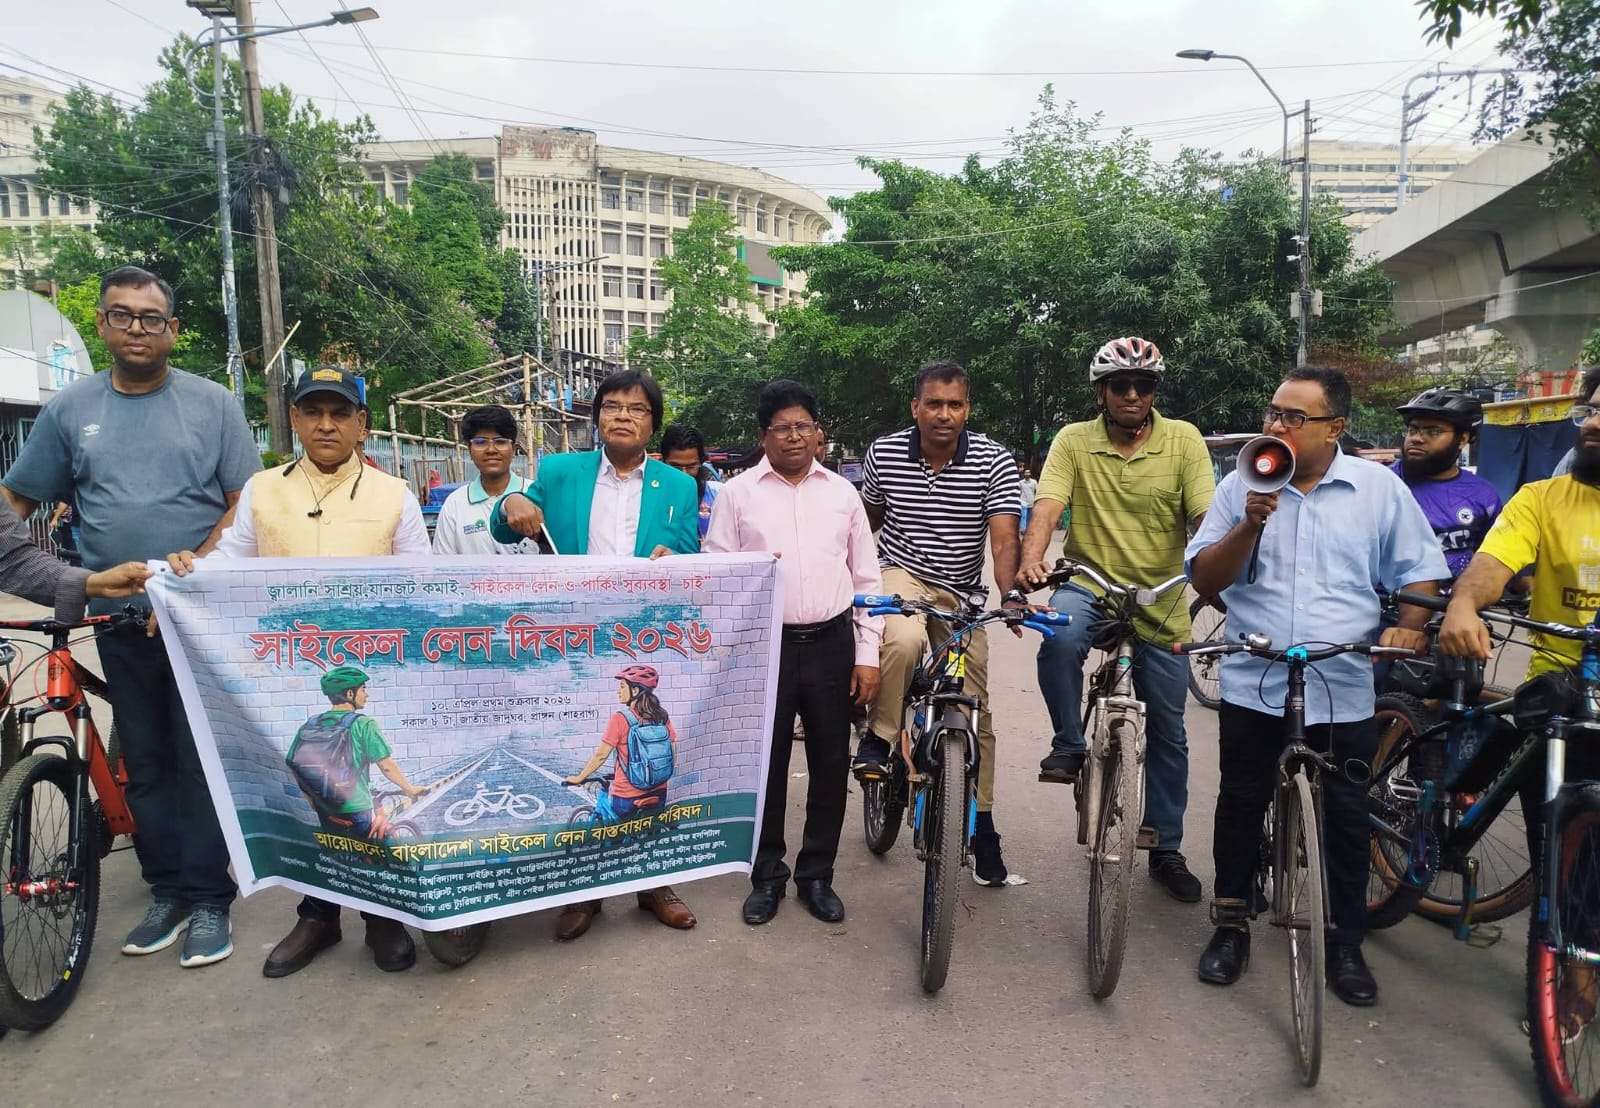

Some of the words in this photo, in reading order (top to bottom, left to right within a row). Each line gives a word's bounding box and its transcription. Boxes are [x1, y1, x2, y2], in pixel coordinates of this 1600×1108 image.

[267, 580, 319, 601] জ্বালানি
[470, 580, 526, 594] সাইকেল
[531, 580, 558, 593] লেন
[564, 581, 575, 592] ও
[582, 576, 619, 592] পার্কিং
[623, 579, 670, 593] সুব্যবস্থা
[249, 619, 410, 672] সাইকেল
[422, 627, 496, 664] লেন
[504, 614, 599, 660] দিবস
[612, 621, 713, 660] ২০২৬
[543, 696, 571, 704] ২০২৬
[392, 839, 473, 863] বাংলাদেশ
[480, 832, 547, 855] সাইকেল
[554, 828, 585, 848] লেন
[591, 815, 652, 841] বাস্তবায়ন
[657, 803, 702, 824] পরিষদ
